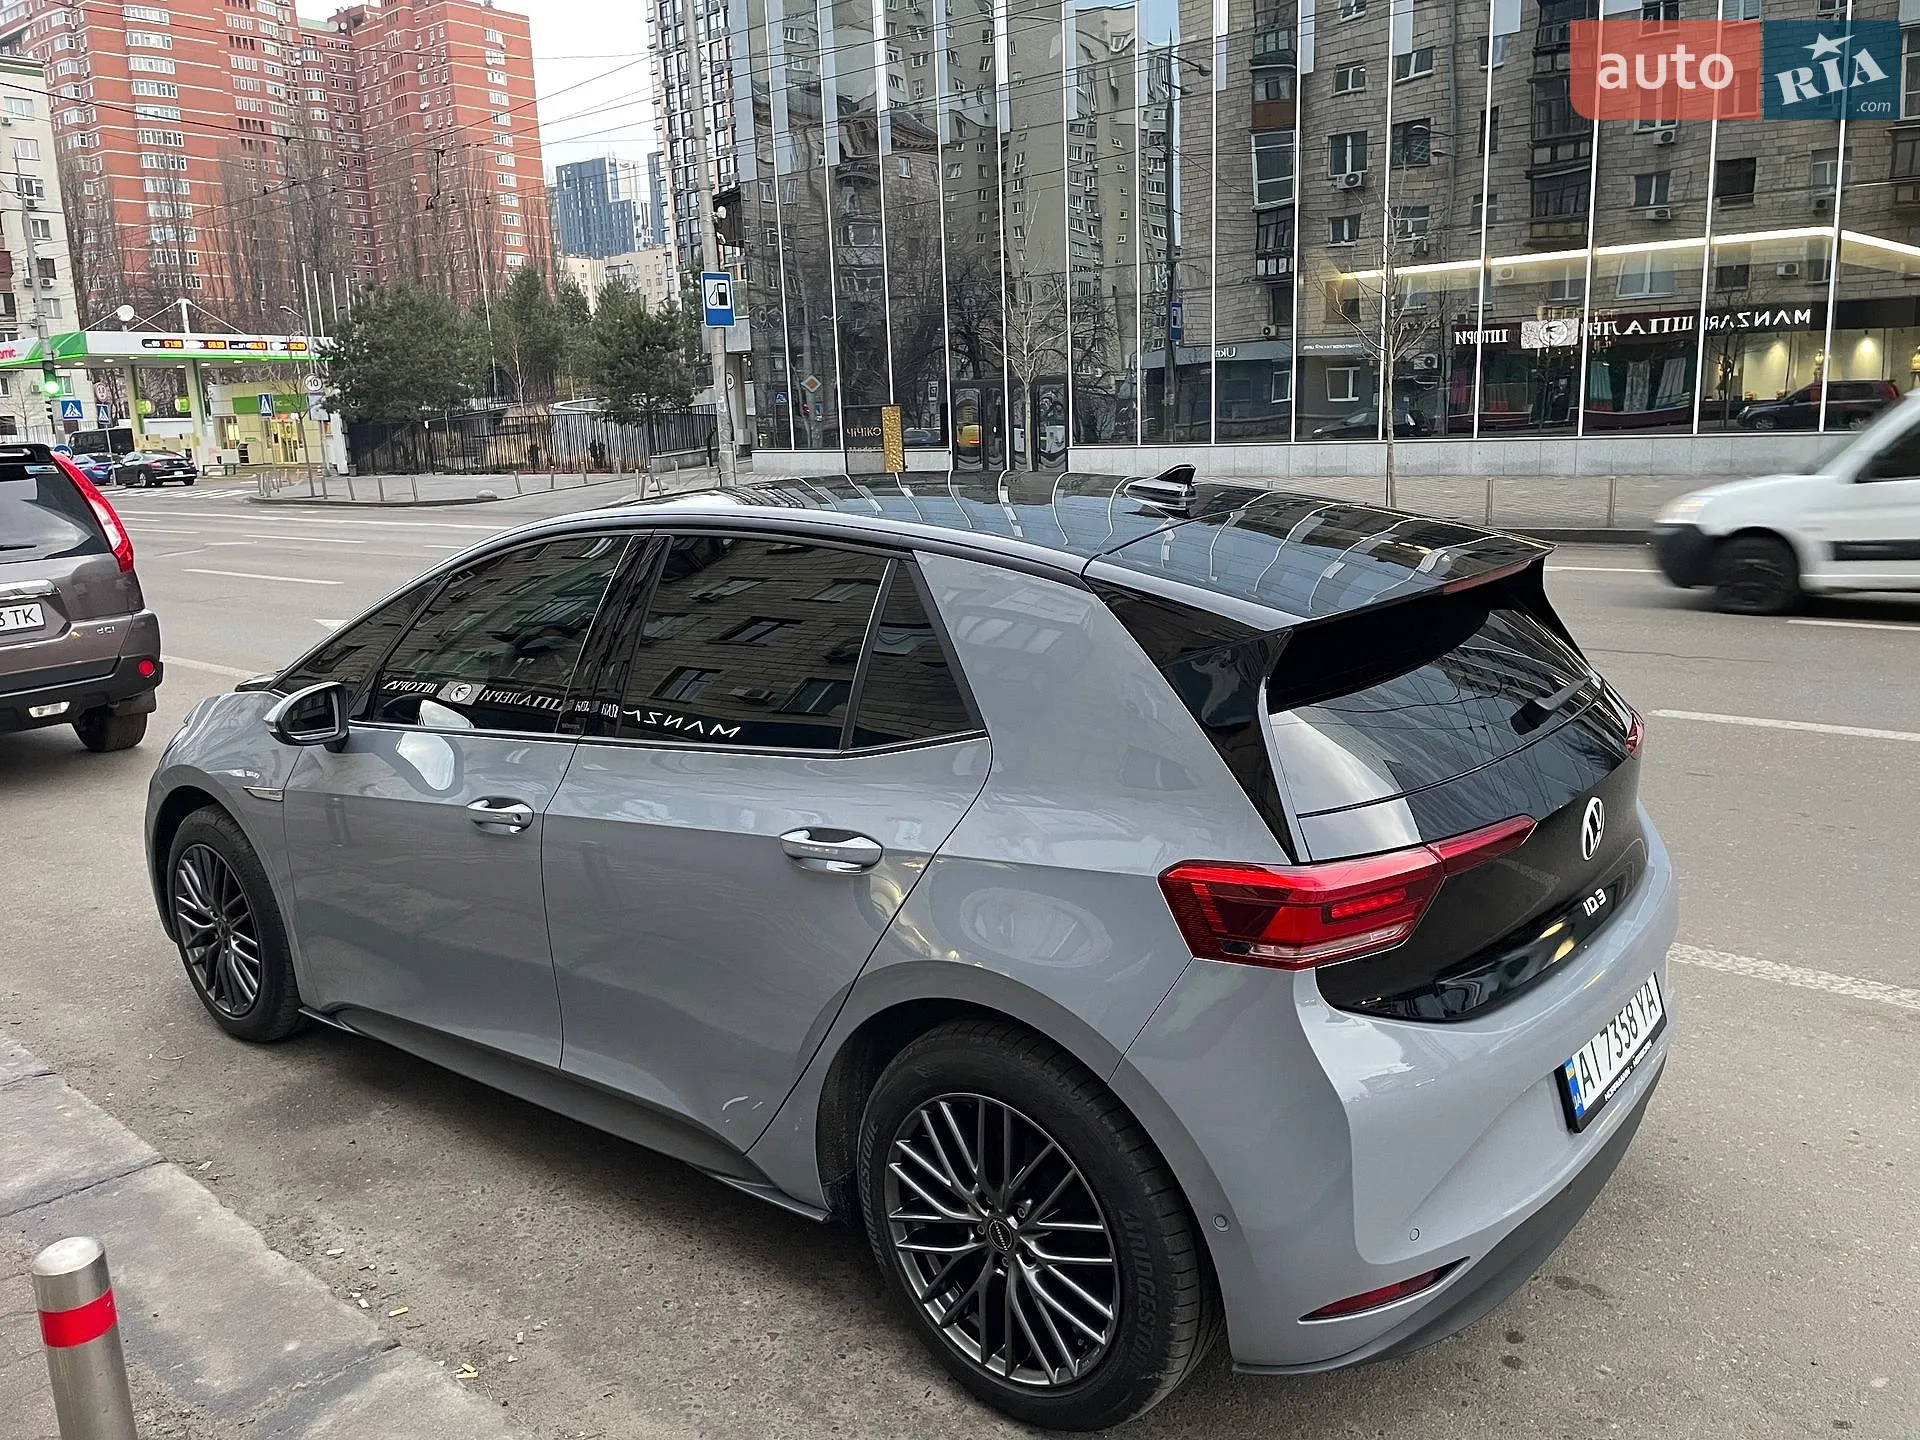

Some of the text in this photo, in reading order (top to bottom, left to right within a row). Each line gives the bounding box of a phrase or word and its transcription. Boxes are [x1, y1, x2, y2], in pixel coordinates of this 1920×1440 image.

[9, 607, 37, 625] TK
[1579, 1040, 1602, 1098] AI
[1600, 1001, 1639, 1071] 7358
